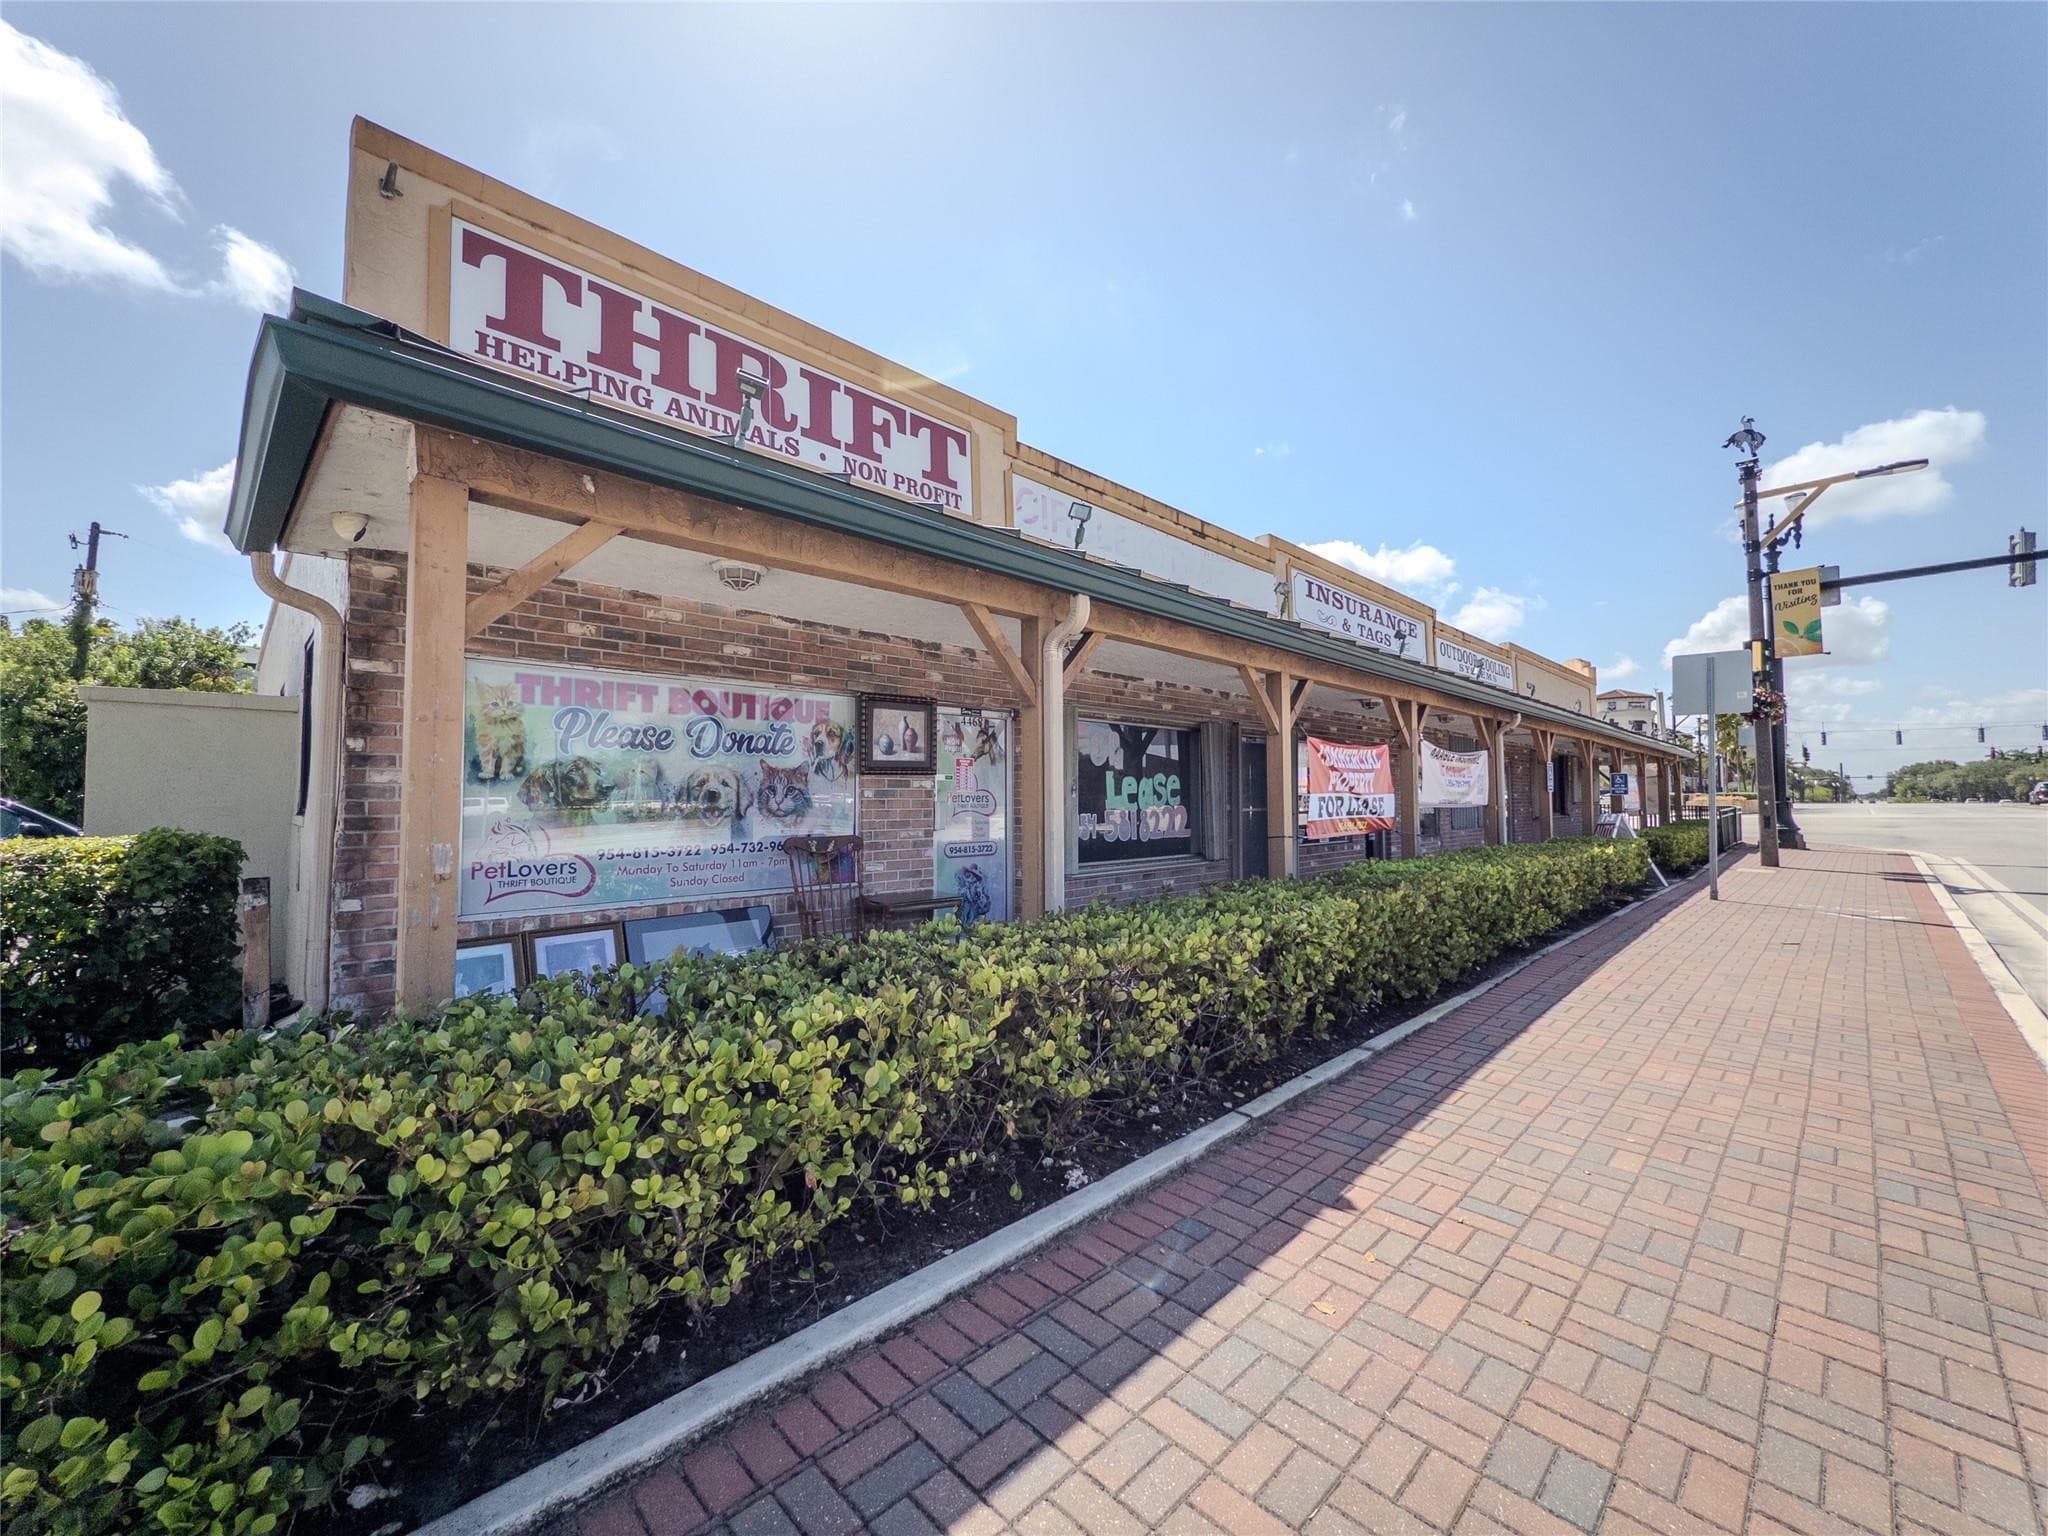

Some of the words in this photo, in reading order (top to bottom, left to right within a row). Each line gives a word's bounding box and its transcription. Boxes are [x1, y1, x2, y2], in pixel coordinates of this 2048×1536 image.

[462, 228, 967, 489] THRIFT
[474, 329, 654, 410] HELPING
[664, 397, 800, 458] ANIMALS
[843, 455, 887, 486] NON
[893, 474, 963, 510] PROFIT
[1774, 581, 1798, 591] THANK
[1801, 578, 1817, 586] YOU
[1788, 588, 1803, 596] FOR
[1305, 579, 1418, 638] INSURANCE
[1774, 593, 1818, 611] Visiting
[1342, 618, 1352, 633] &
[1357, 623, 1392, 647] TAGS
[1459, 664, 1498, 682] SYSEMS
[514, 672, 658, 713] THRIFT
[668, 686, 831, 724] BOUTIQUE
[553, 706, 674, 755] Please
[685, 716, 796, 759] Donate
[1105, 770, 1181, 811] Lease
[1317, 795, 1345, 818] FOR
[1346, 795, 1385, 817] LEASE
[710, 841, 784, 856] 954-732-96
[471, 861, 577, 880] PetLovers
[616, 865, 663, 876] Monday
[667, 862, 679, 873] To
[683, 857, 728, 873] Saturday
[731, 858, 758, 869] 11am
[768, 857, 788, 868] 7pm
[497, 879, 529, 889] THRIFT
[530, 876, 577, 887] BOUTIQUE
[670, 876, 709, 888] Sunday
[712, 872, 745, 884] Closed
